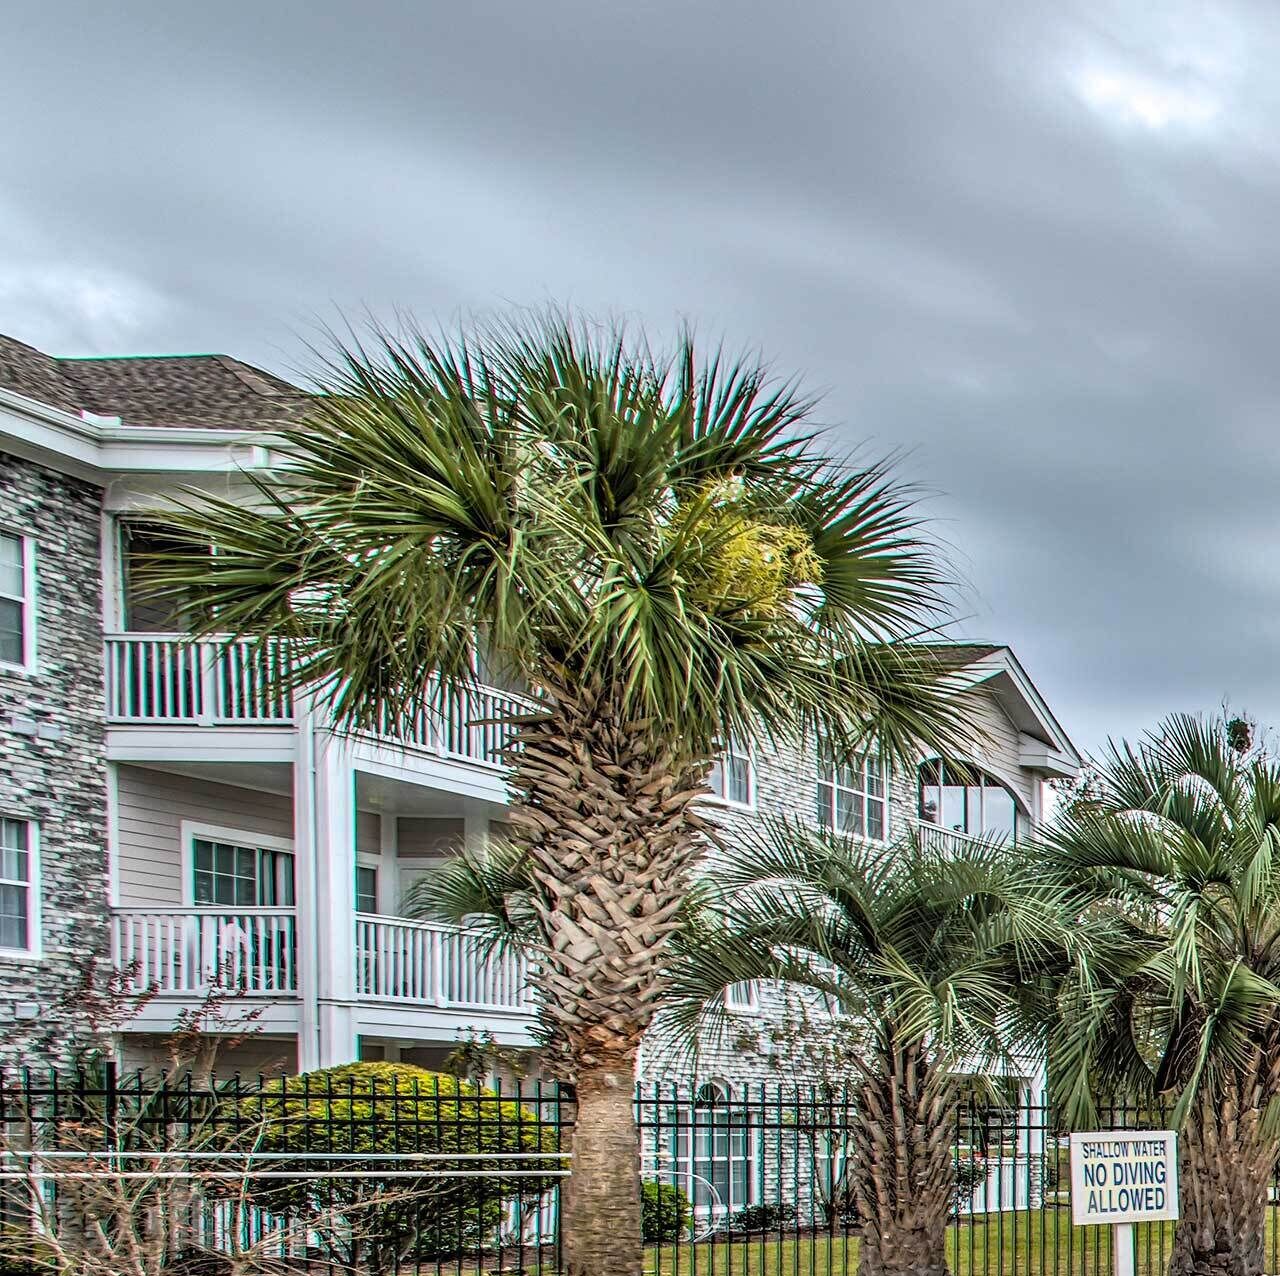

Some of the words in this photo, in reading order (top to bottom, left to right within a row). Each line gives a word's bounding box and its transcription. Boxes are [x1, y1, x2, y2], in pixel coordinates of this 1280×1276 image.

[1083, 1141, 1129, 1159] SHALLOW
[1133, 1140, 1166, 1157] WATER
[1084, 1163, 1107, 1187] NO
[1113, 1161, 1166, 1186] DIVING
[1088, 1187, 1165, 1213] ALLOWED
